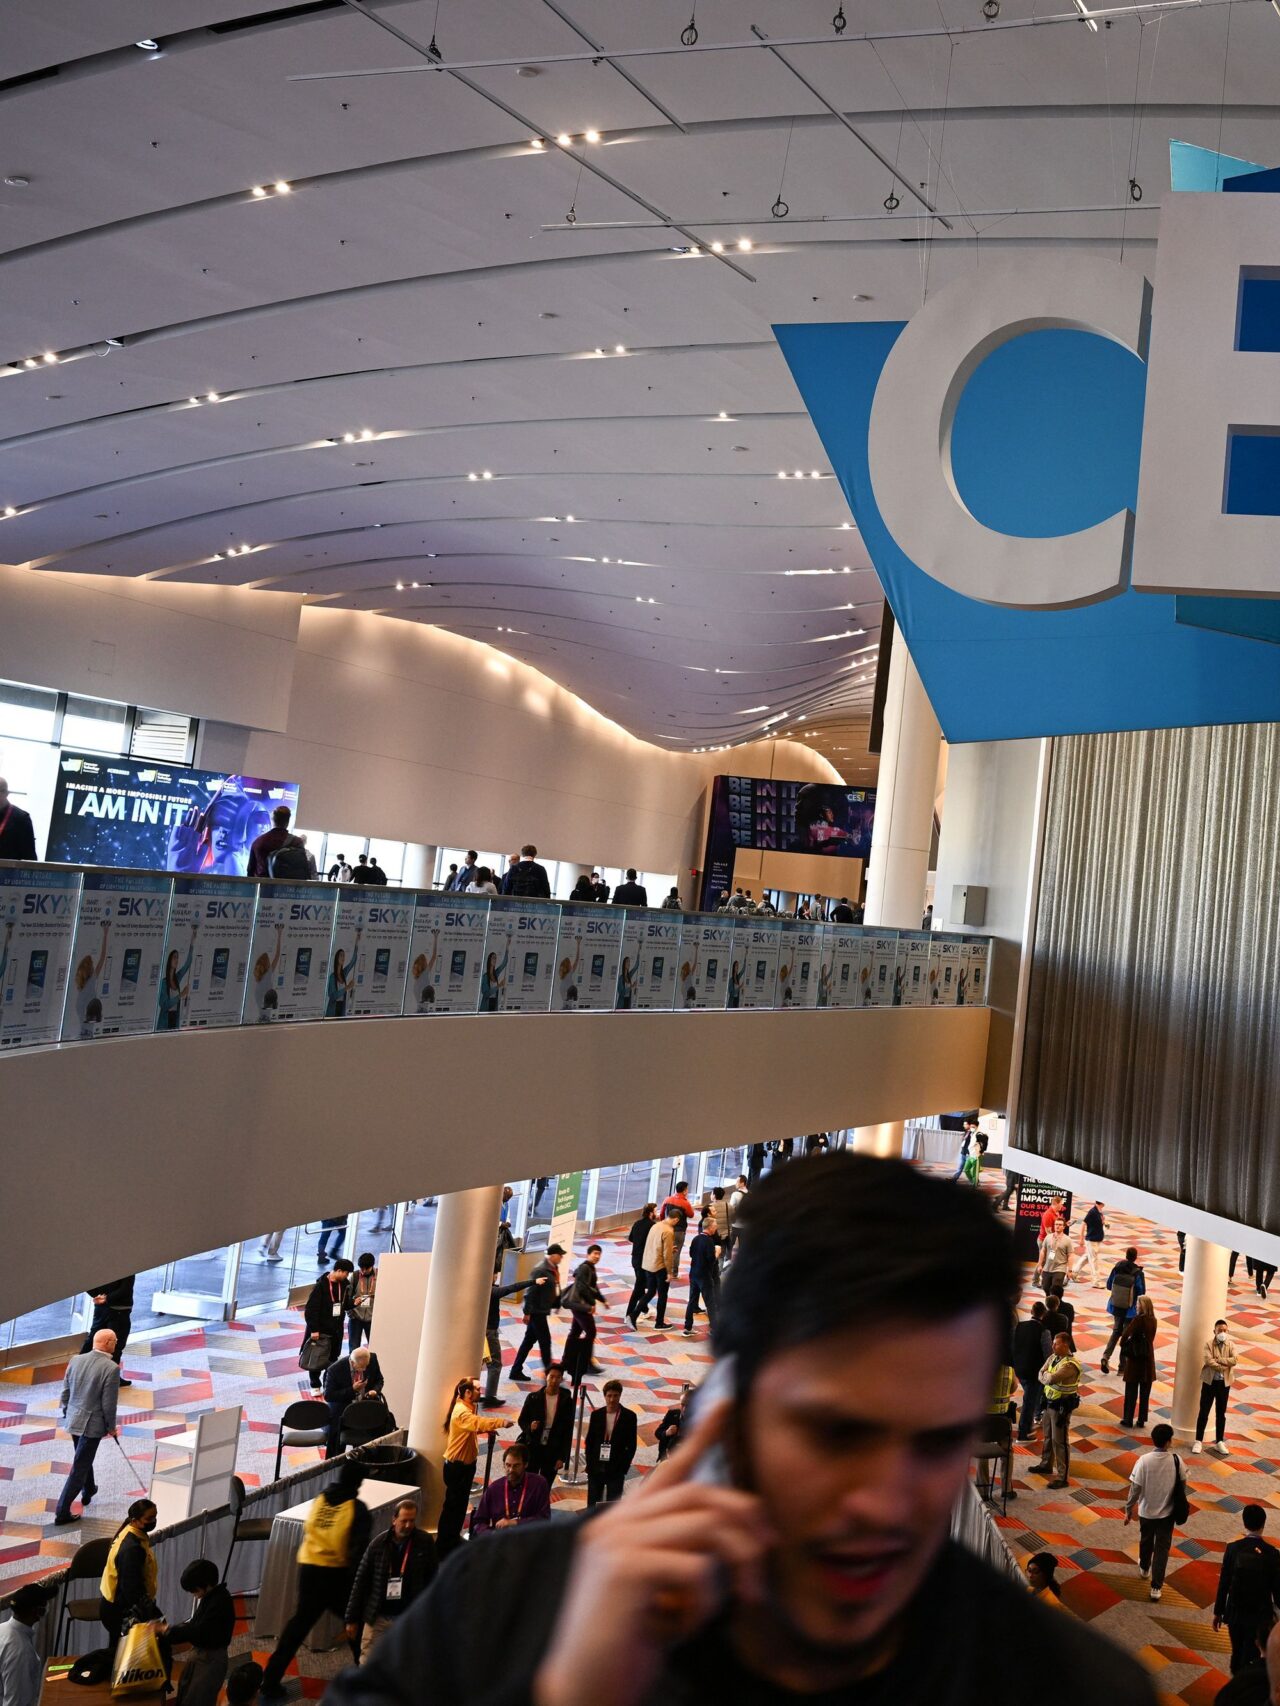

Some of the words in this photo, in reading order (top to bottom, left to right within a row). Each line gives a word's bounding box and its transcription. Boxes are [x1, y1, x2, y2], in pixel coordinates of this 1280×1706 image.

[66, 782, 98, 793] IMAGINE
[106, 787, 126, 796] MORE
[127, 790, 167, 802] IMPOSSIBLE
[167, 795, 193, 805] FUTURE
[729, 777, 752, 795] BE
[756, 781, 777, 797] IN
[781, 782, 799, 799] IT
[728, 794, 752, 811] BE
[756, 799, 777, 815] IN
[781, 801, 797, 816] IT
[847, 793, 863, 802] CES
[64, 790, 75, 815] I
[77, 792, 126, 820] AM
[131, 798, 160, 825] IN
[163, 803, 189, 827] IT
[729, 812, 752, 829] BE
[756, 816, 777, 832] IN
[781, 817, 797, 833] IT
[731, 829, 752, 845] BE
[756, 832, 777, 848] IN
[22, 893, 73, 914] SKYX
[117, 897, 166, 916] SKYX
[206, 901, 252, 919] SKYX
[290, 904, 331, 920] SKYX
[368, 908, 410, 924] SKYX
[445, 912, 485, 927] SKYX
[518, 916, 556, 931] SKYX
[586, 920, 620, 934] SKYX
[647, 925, 677, 937] SKYX
[703, 929, 731, 941] SKYX
[752, 932, 778, 943] SKYX
[1020, 1194, 1053, 1203] IMPACT
